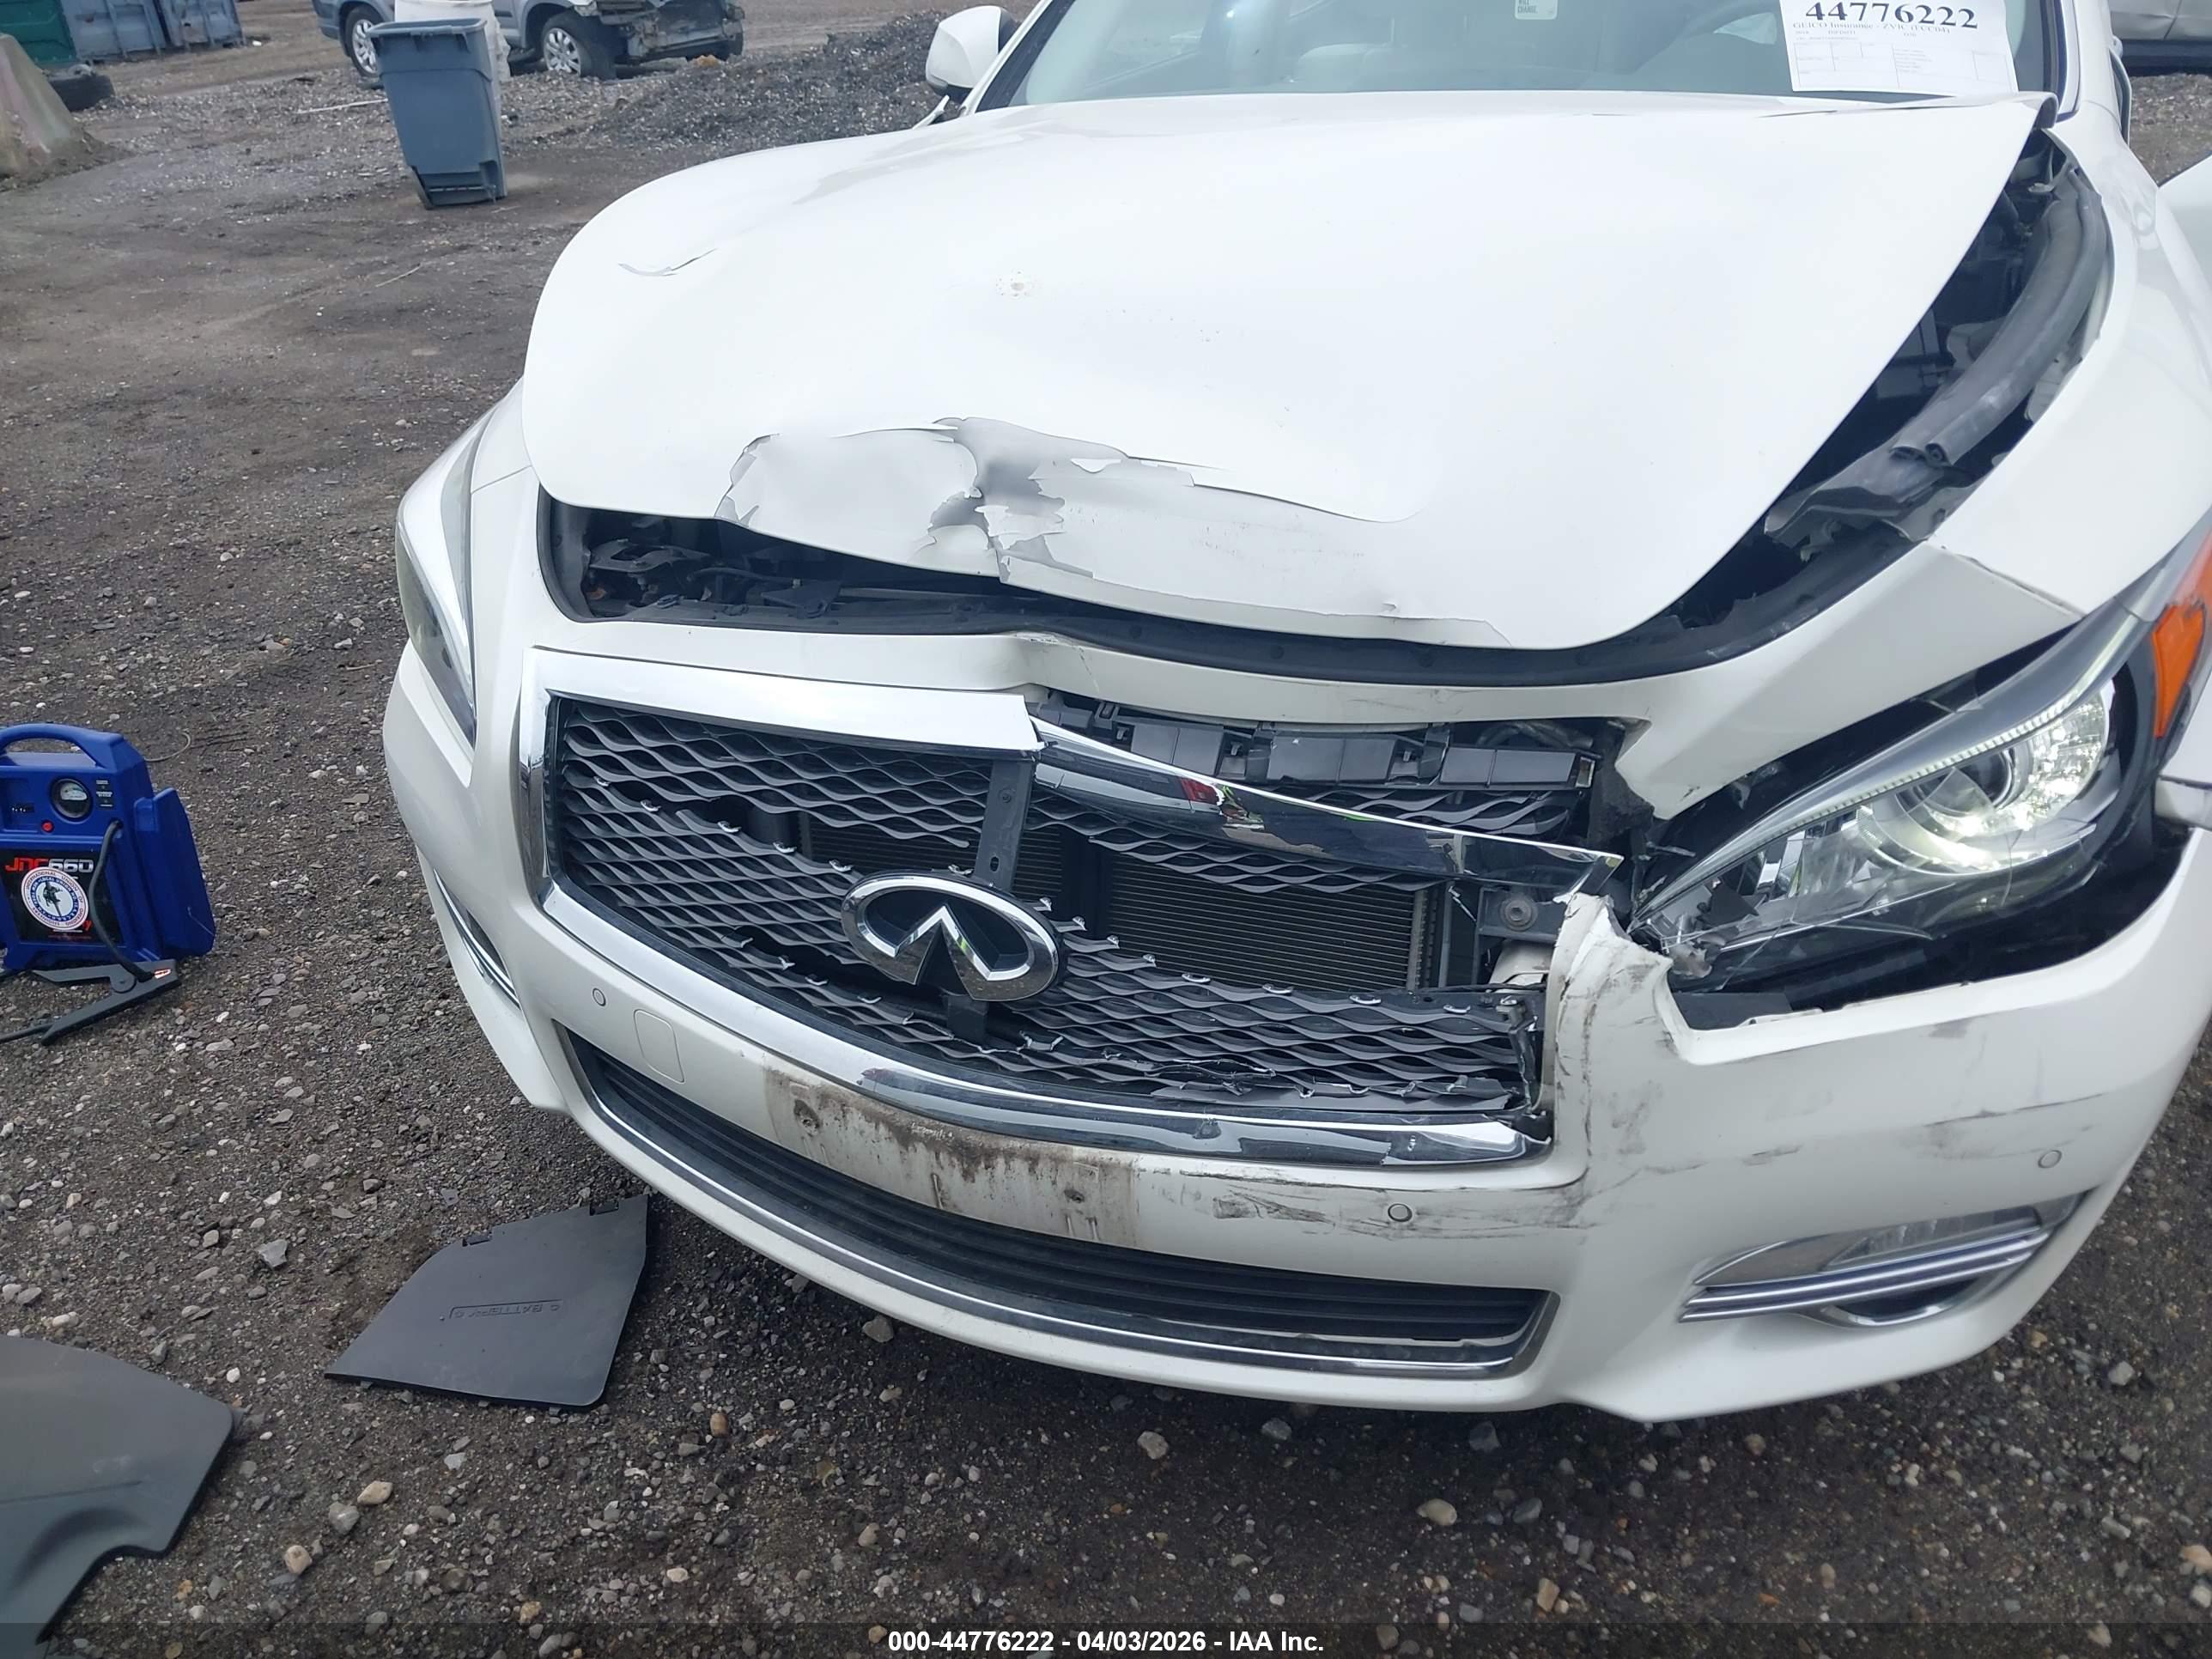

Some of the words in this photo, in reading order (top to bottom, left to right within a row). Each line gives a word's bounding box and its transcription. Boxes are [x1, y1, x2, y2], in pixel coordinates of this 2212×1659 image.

[1806, 2, 1978, 29] 44776222
[1830, 21, 1874, 30] Insurance
[61, 876, 78, 891] UNION
